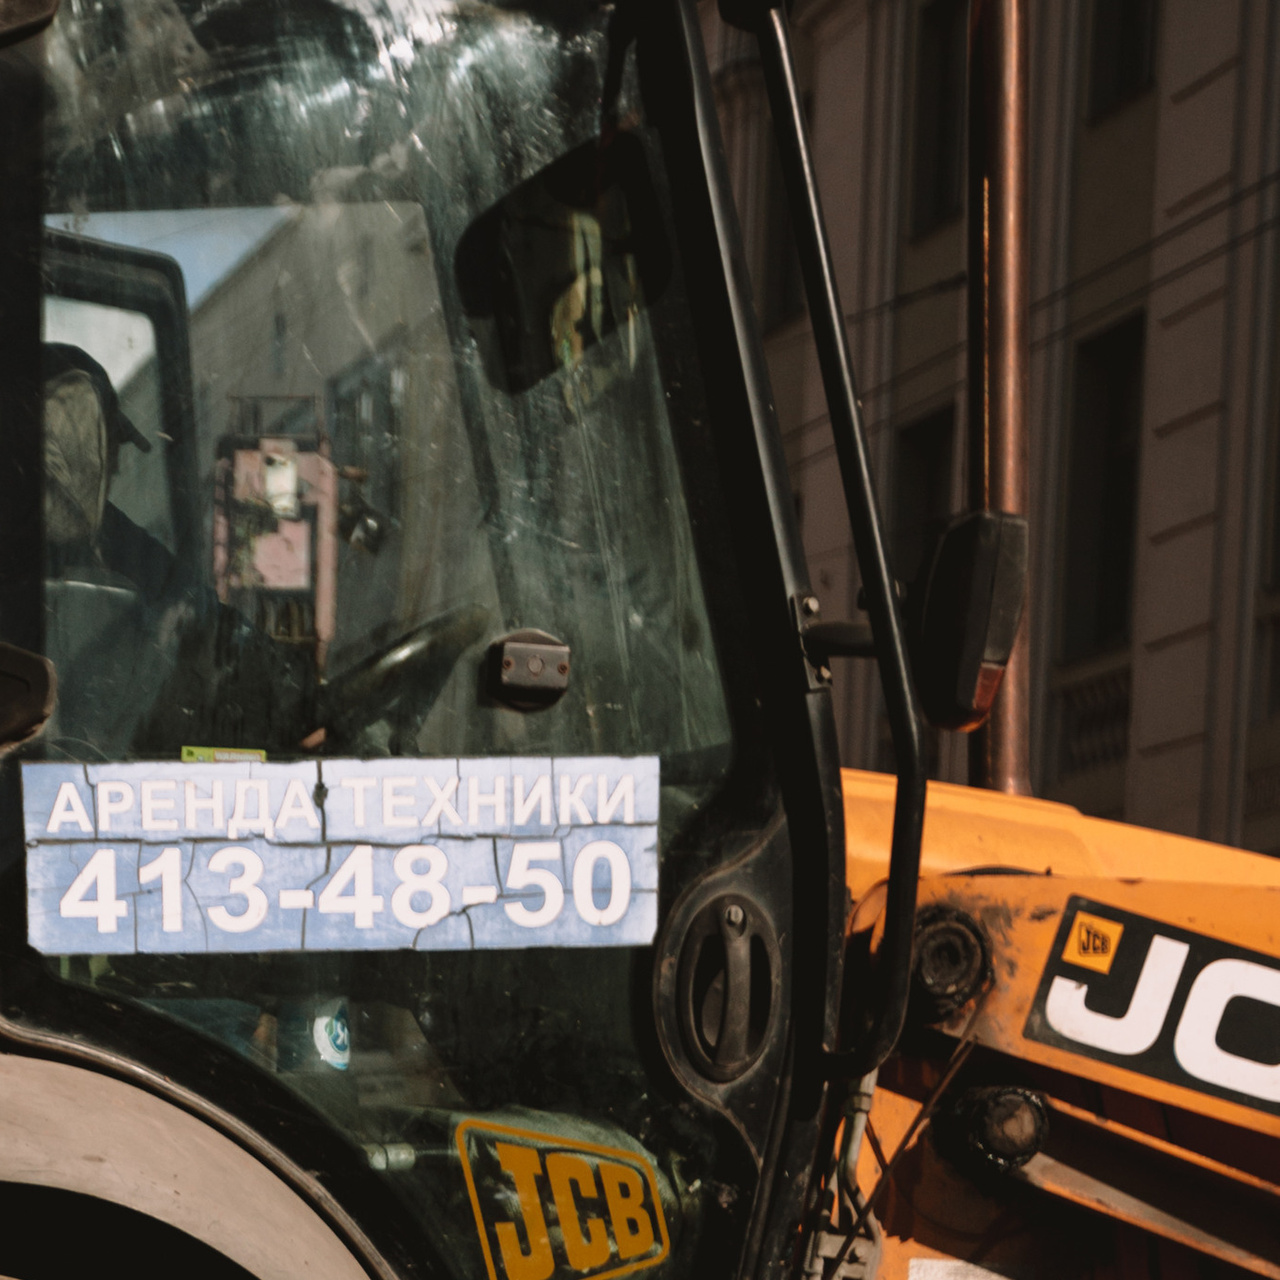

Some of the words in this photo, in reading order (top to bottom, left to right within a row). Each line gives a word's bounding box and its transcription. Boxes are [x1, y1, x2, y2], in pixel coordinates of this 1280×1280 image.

[46, 779, 320, 839] АРЕНДА
[340, 774, 635, 827] ТЕХНИКИ
[60, 840, 631, 933] 413-48-50
[1080, 928, 1111, 955] JCB
